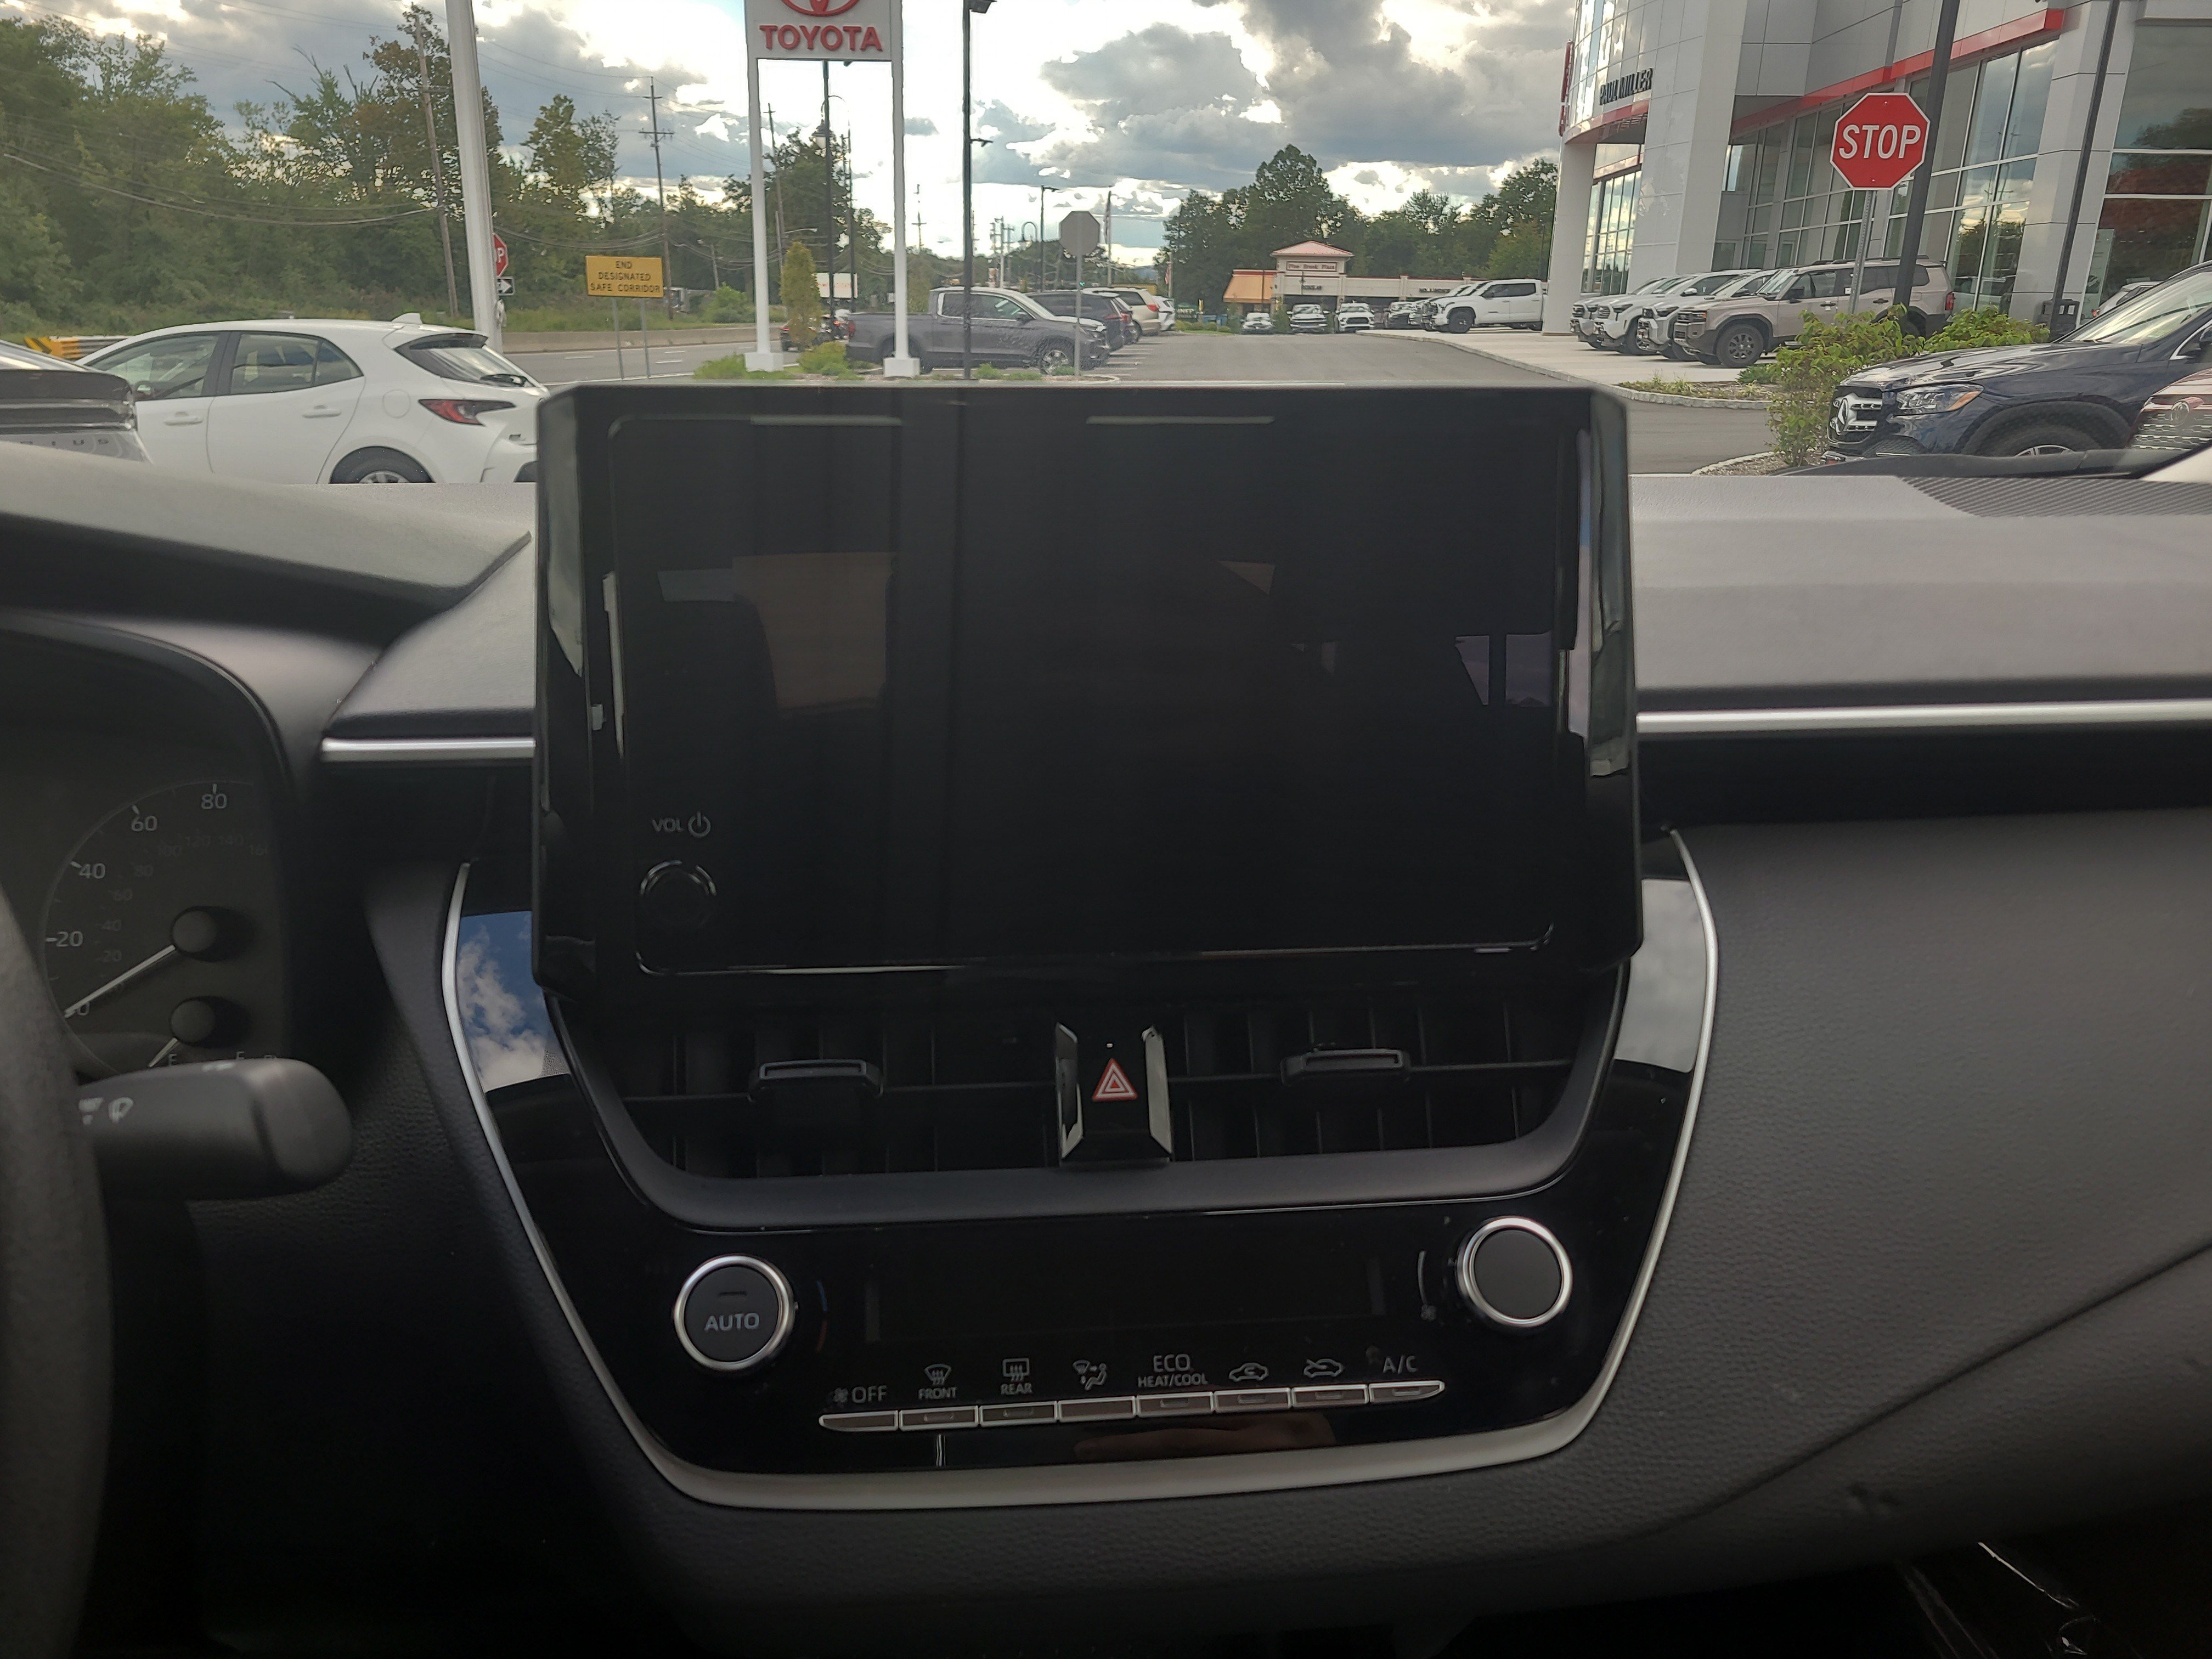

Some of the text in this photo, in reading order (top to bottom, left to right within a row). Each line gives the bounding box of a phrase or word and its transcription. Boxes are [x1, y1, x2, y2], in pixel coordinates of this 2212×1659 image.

[759, 24, 883, 52] TOYOTA
[1599, 67, 1654, 106] PAUL MILLER
[1839, 124, 1921, 159] STOP
[616, 261, 632, 269] END
[598, 272, 651, 281] DESIGNATED
[590, 283, 660, 293] SAFE CORRIDOR
[201, 793, 228, 810] 80
[131, 815, 158, 832] 60
[651, 816, 685, 832] VOL
[78, 862, 106, 879] 40
[55, 930, 83, 948] 20
[704, 1312, 760, 1332] AUTO
[1153, 1353, 1191, 1373] ECO
[1383, 1355, 1418, 1375] A/C
[1000, 1382, 1034, 1395] REAR
[1137, 1372, 1209, 1389] HEAT/COOL
[851, 1385, 888, 1404] OFF
[917, 1386, 957, 1400] FRONT
